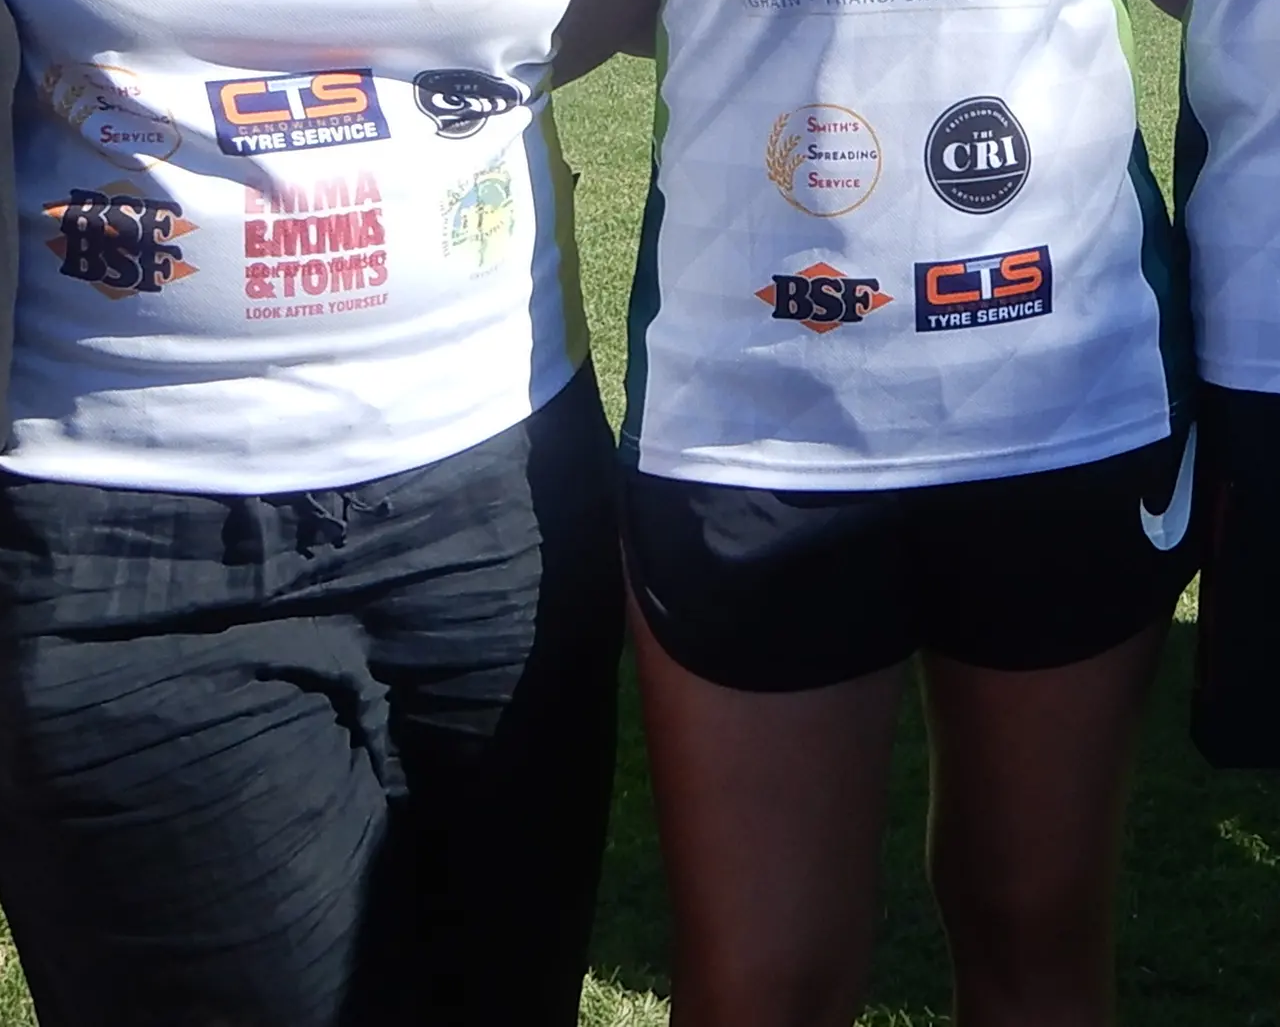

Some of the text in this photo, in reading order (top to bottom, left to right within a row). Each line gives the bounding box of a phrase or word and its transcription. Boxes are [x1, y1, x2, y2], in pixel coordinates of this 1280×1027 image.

[220, 73, 368, 125] CTS
[232, 122, 378, 152] TYRE SERVICE
[238, 114, 365, 135] CANOWINDRA
[943, 136, 1018, 172] CRI
[927, 251, 1042, 305] CTS
[246, 292, 389, 320] LOOK AFTER YOURSELF
[772, 274, 880, 322] BSF
[928, 312, 972, 328] TYRE
[977, 299, 1043, 323] SERVICE
